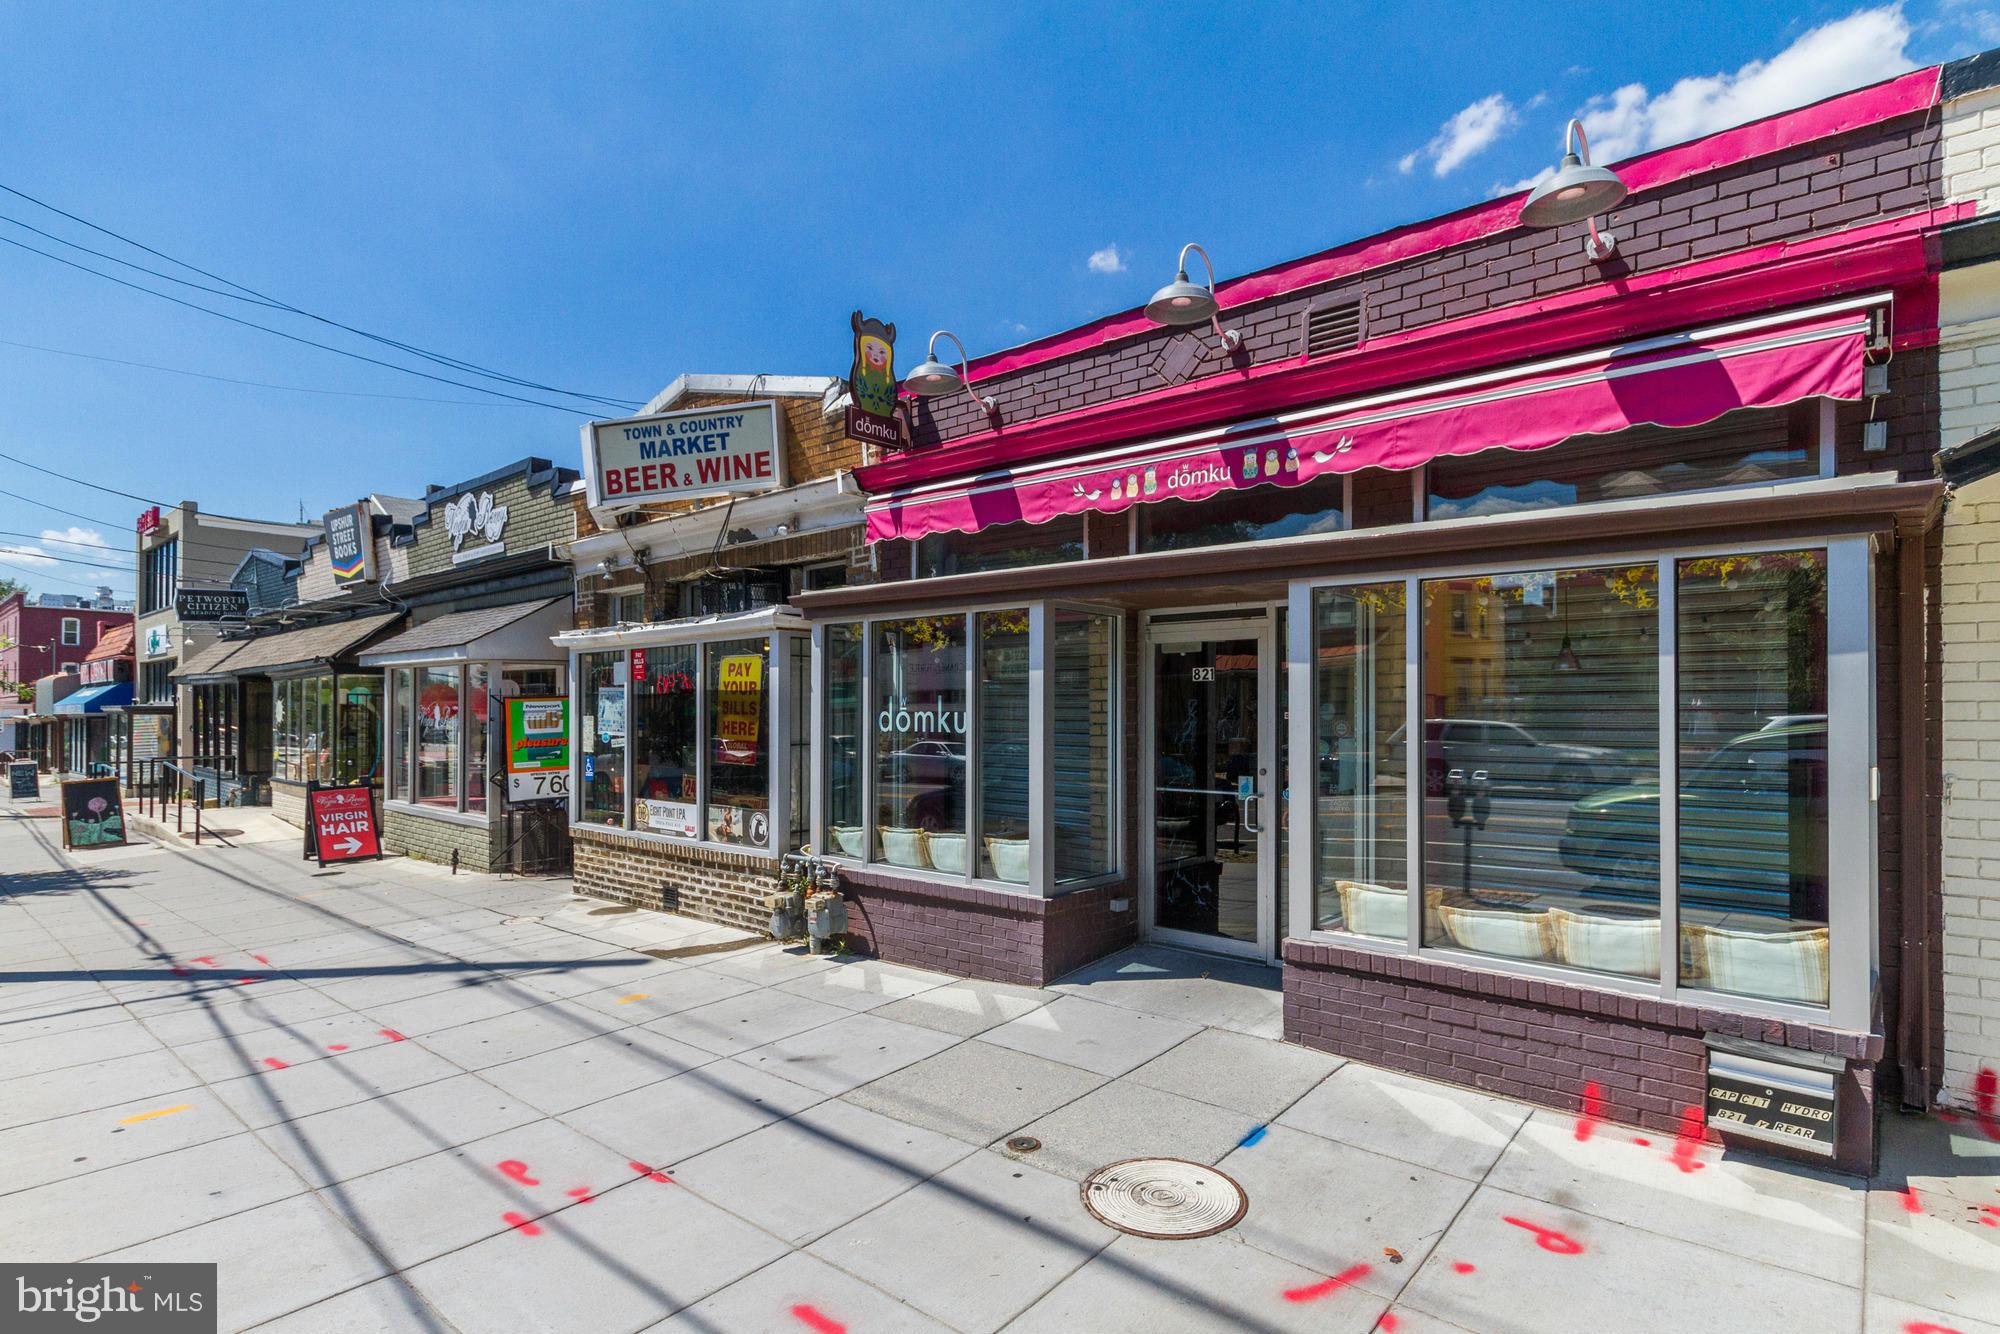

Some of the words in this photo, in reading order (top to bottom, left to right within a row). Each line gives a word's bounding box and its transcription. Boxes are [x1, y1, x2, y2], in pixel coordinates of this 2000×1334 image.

[623, 425, 662, 441] TOWN
[666, 423, 676, 436] &
[679, 415, 744, 434] COUNTRY
[639, 432, 730, 460] MARKET
[606, 463, 679, 495] BEER
[683, 473, 693, 486] &
[696, 451, 772, 484] WINE
[330, 514, 354, 532] UPSHUR
[332, 528, 355, 545] STREET
[333, 542, 357, 559] BOOKS
[179, 595, 245, 604] PETWORTH
[187, 603, 238, 611] CITIZEN
[728, 662, 752, 677] PAY
[1193, 668, 1214, 680] 821
[723, 680, 757, 696] YOUR
[722, 700, 757, 716] BILLS
[722, 720, 756, 737] HERE
[513, 779, 521, 789] $
[321, 811, 368, 822] VIRGIN
[321, 821, 369, 836] HAIR
[1711, 1088, 1737, 1101] CAP
[1741, 1095, 1769, 1107] CIT
[1783, 1104, 1833, 1121] HYDRO
[1718, 1110, 1742, 1122] 821
[1775, 1122, 1812, 1138] REAR
